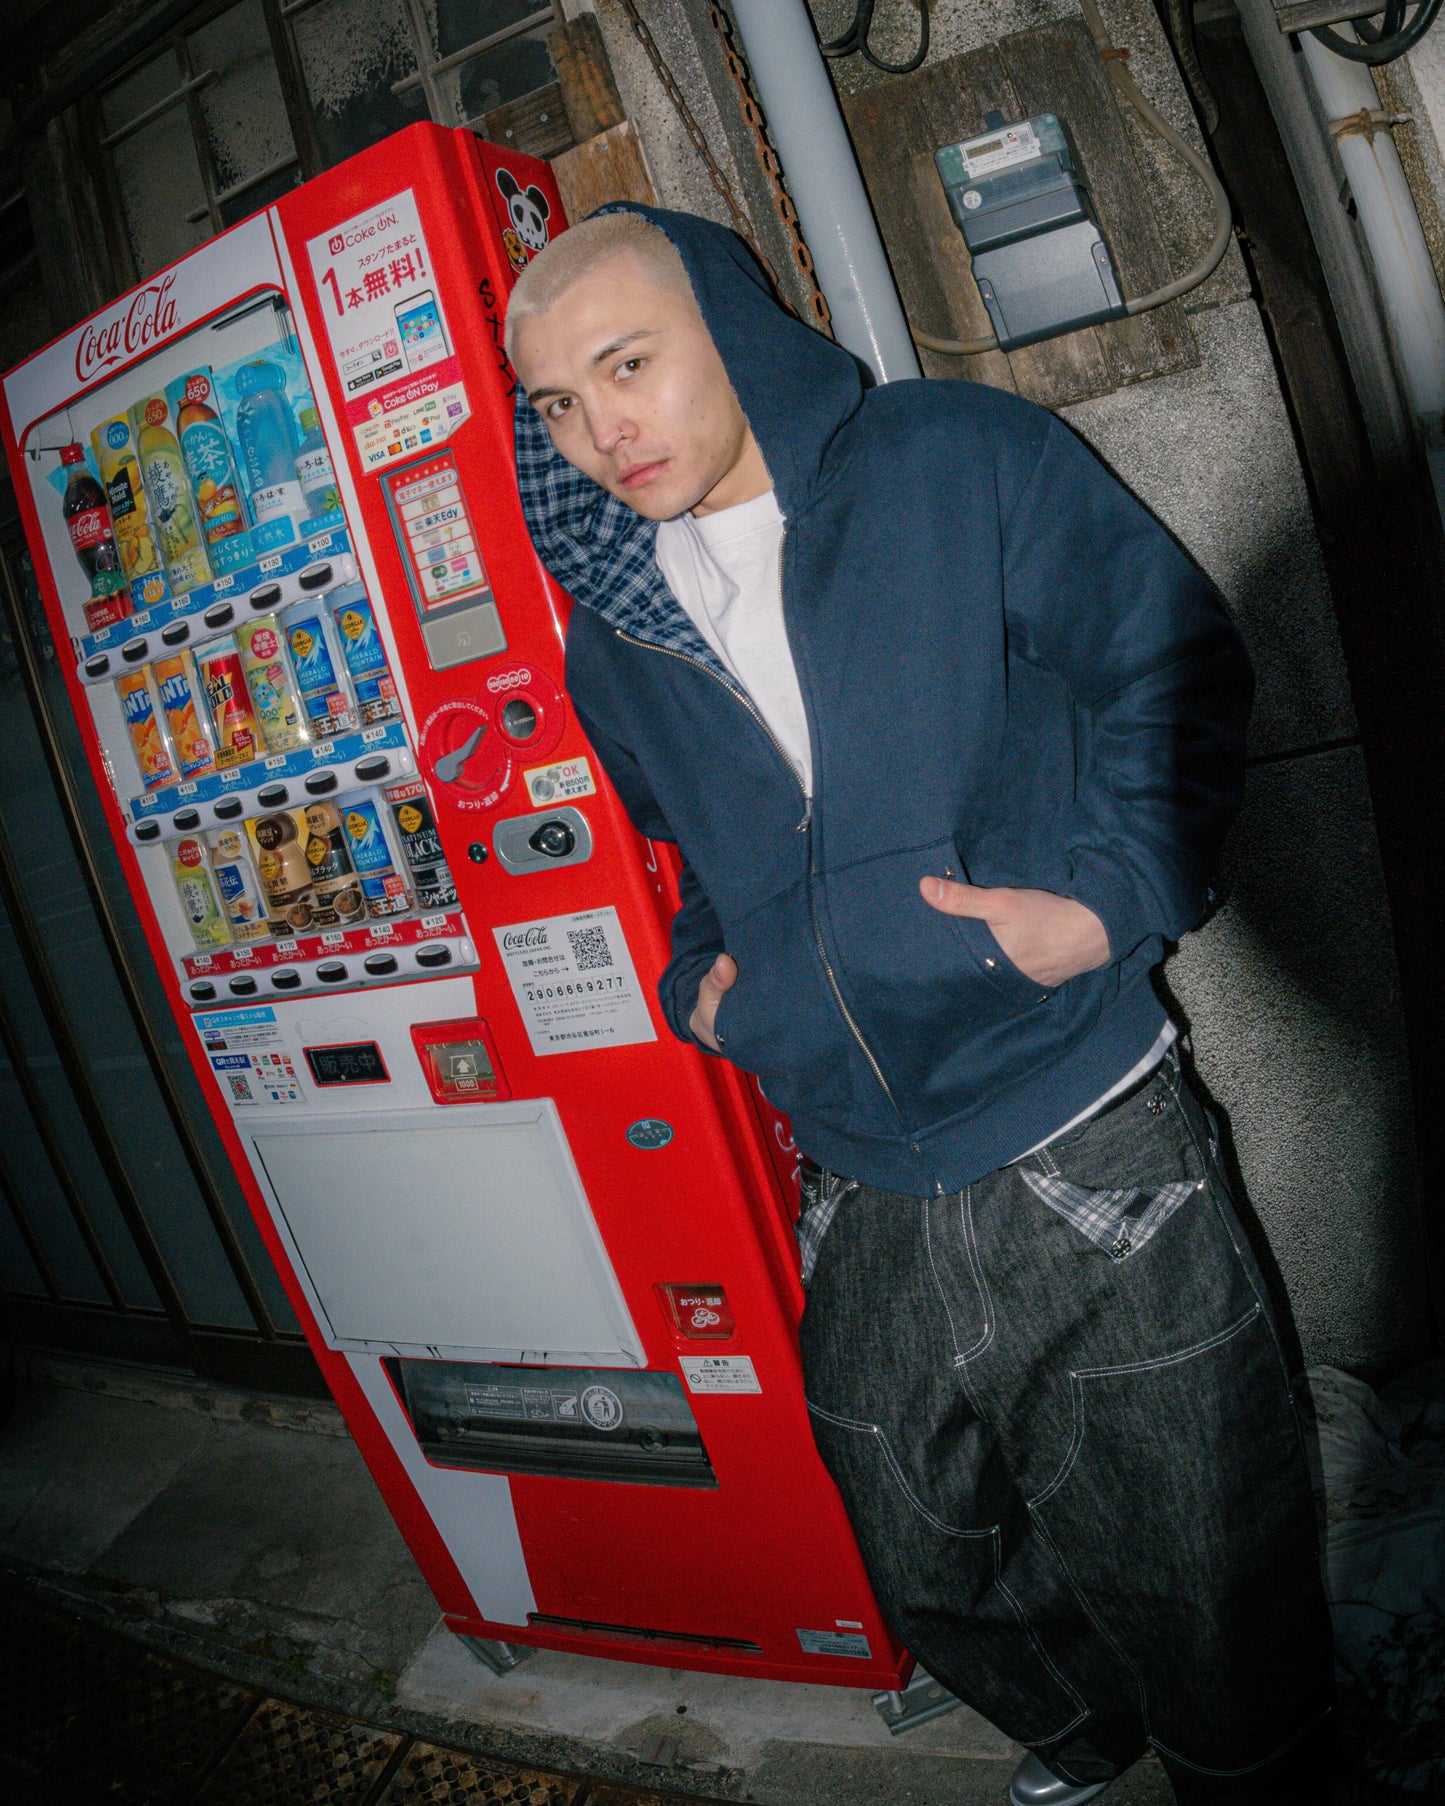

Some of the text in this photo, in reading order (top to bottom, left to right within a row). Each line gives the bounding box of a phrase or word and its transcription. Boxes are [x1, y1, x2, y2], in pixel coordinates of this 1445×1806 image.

[345, 225, 376, 248] Coke
[357, 233, 418, 269] スタンプたまると
[321, 247, 427, 317] 1本無料!
[75, 271, 178, 382] Coca-Cola
[187, 383, 208, 400] 650
[384, 394, 407, 409] Coke
[420, 381, 440, 393] Pay
[413, 407, 425, 415] LINE
[368, 450, 386, 462] VISA
[425, 508, 458, 528] 楽天Edy
[311, 538, 330, 549] ¥100
[263, 558, 280, 569] ¥130
[319, 714, 351, 735] 王道
[366, 730, 384, 740] ¥140
[315, 745, 332, 755] ¥140
[223, 770, 239, 779] ¥140
[562, 765, 579, 777] OK
[559, 775, 590, 789] 新旧500円
[564, 784, 589, 796] 使えます
[376, 896, 411, 916] 王道
[425, 916, 444, 927] ¥120
[373, 925, 391, 934] ¥140
[326, 933, 342, 942] ¥160
[503, 925, 548, 951] Coca-Cola
[279, 942, 295, 951] ¥170
[522, 954, 566, 968] 故障・お問合せは
[532, 967, 561, 978] こちらから
[527, 976, 623, 1001] 2906669277
[318, 1053, 376, 1074] 販売中
[459, 1079, 475, 1088] 1000
